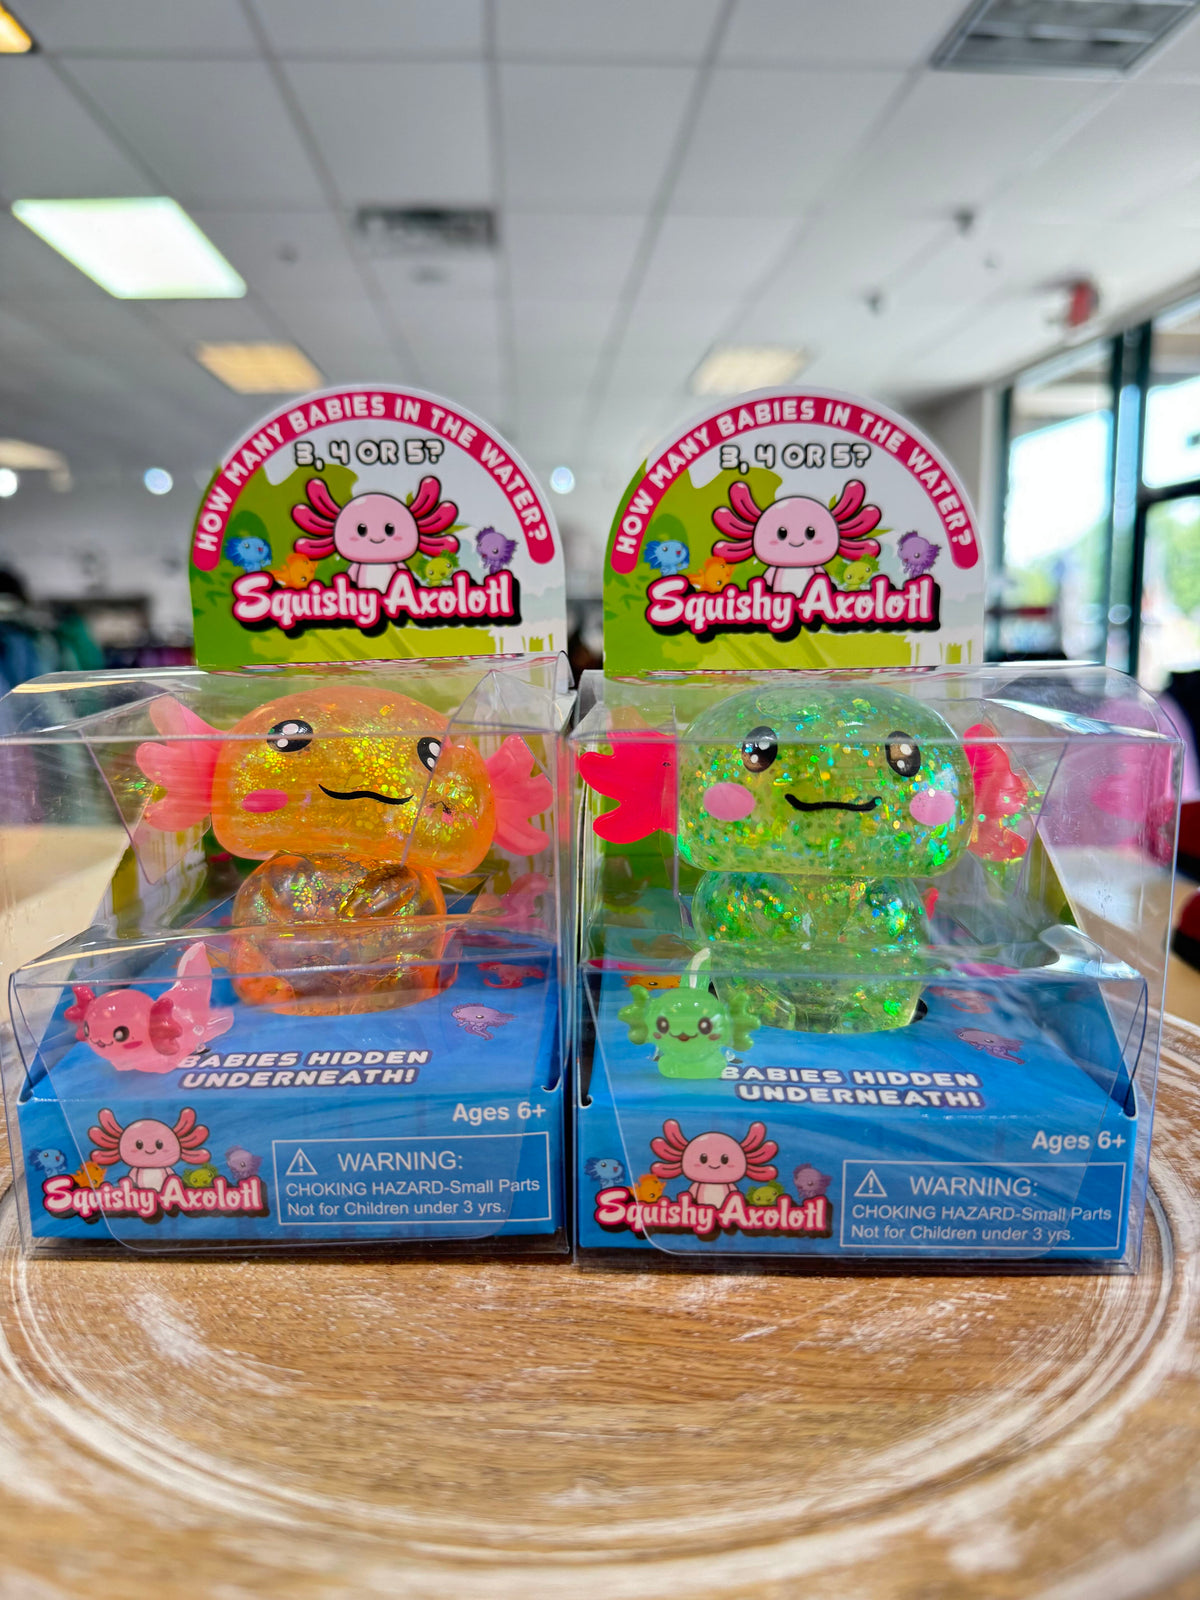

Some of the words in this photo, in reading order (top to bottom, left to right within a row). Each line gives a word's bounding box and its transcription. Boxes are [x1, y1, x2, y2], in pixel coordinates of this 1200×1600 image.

[295, 442, 325, 470] 3,
[329, 442, 350, 465] 4
[357, 441, 399, 464] OR
[406, 439, 445, 463] 5?
[720, 445, 749, 474] 3,
[755, 445, 775, 468] 4
[782, 445, 824, 468] OR
[831, 444, 871, 467] 5?
[199, 487, 230, 551] HOW
[227, 424, 283, 486] MANY
[289, 397, 385, 434] BABIES
[394, 399, 420, 422] IN
[431, 410, 477, 448] THE
[481, 443, 547, 541] WATER?
[616, 495, 653, 554] HOW
[649, 432, 711, 489] MANY
[717, 401, 815, 437] BABIES
[824, 403, 850, 426] IN
[859, 414, 906, 452] THE
[907, 447, 973, 547] WATER?
[234, 572, 380, 629] Squishy
[385, 570, 513, 617] Axolotl
[647, 576, 795, 632] Squishy
[799, 573, 933, 624] Axolotl
[178, 1052, 299, 1068] BABIES
[307, 1051, 429, 1066] HIDDEN
[182, 1069, 415, 1088] UNDERNEATH!
[722, 1066, 842, 1083] BABIES
[853, 1071, 979, 1087] HIDDEN
[738, 1085, 981, 1107] UNDERNEATH!
[452, 1103, 510, 1126] Ages
[517, 1102, 546, 1119] 6+
[1032, 1131, 1090, 1153] Ages
[1098, 1131, 1126, 1148] 6+
[338, 1151, 463, 1172] WARNING:
[44, 1175, 157, 1217] Squishy
[160, 1175, 262, 1212] Axolotl
[286, 1182, 367, 1196] CHOKING
[372, 1180, 493, 1195] HAZARD-Small
[500, 1179, 540, 1192] Parts
[910, 1176, 1038, 1196] WARNING:
[288, 1202, 315, 1216] Not
[319, 1202, 339, 1215] for
[344, 1201, 409, 1215] Children
[414, 1201, 459, 1214] under
[463, 1201, 473, 1213] 3
[477, 1202, 506, 1217] yrs.
[596, 1187, 715, 1234] Squishy
[719, 1192, 827, 1230] Axolotl
[852, 1205, 935, 1219] CHOKING
[942, 1207, 1065, 1221] HAZARD-Small
[1071, 1207, 1111, 1220] Parts
[852, 1225, 879, 1238] Not
[884, 1226, 905, 1238] for
[910, 1226, 977, 1239] Children
[982, 1227, 1026, 1240] under
[1032, 1228, 1042, 1240] 3
[1047, 1229, 1075, 1244] yrs.
